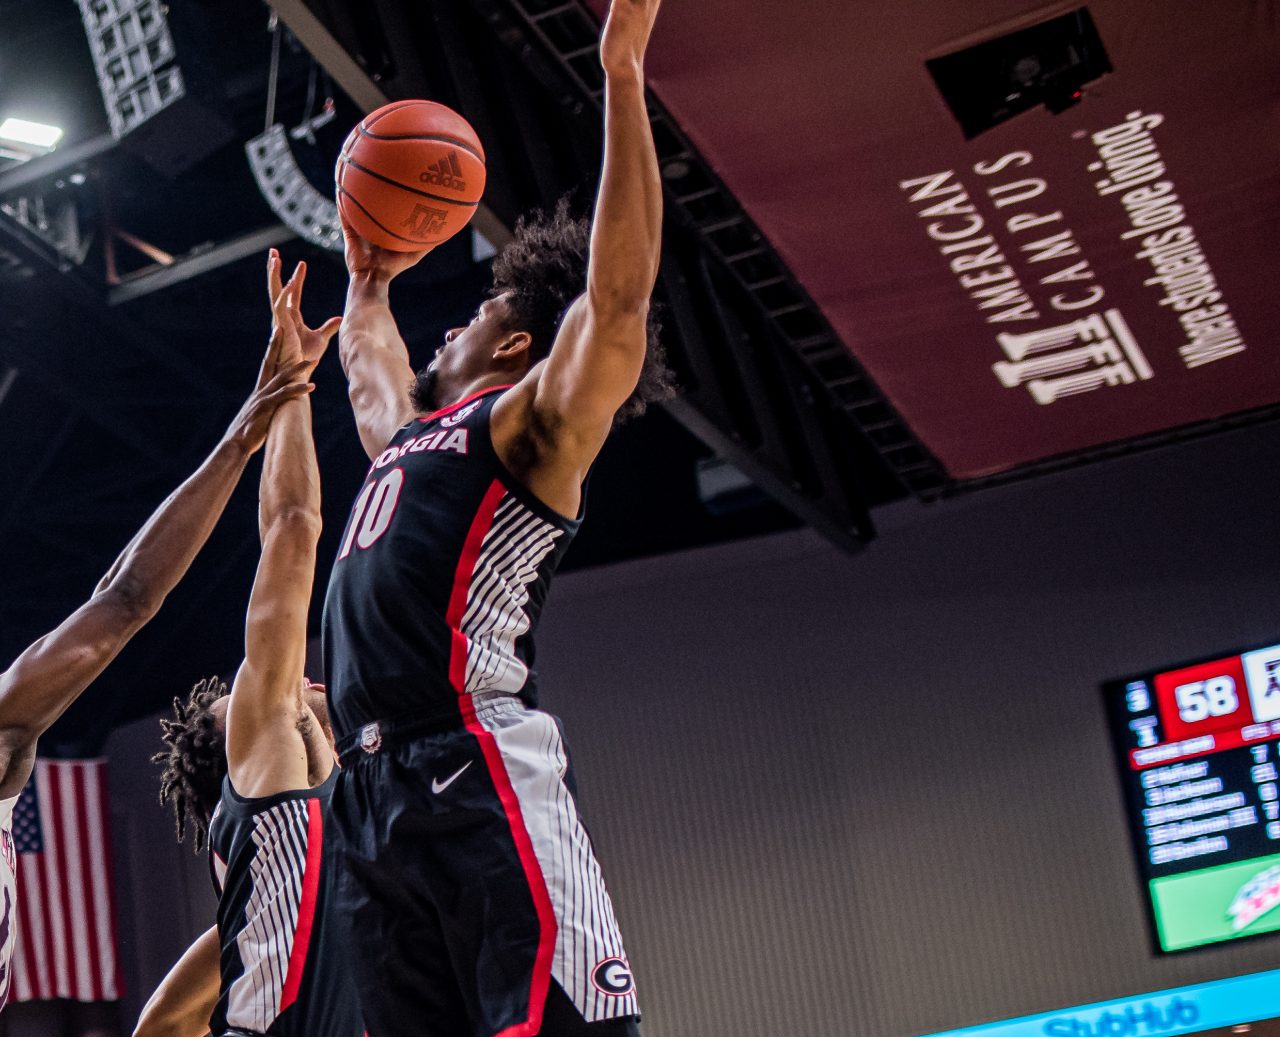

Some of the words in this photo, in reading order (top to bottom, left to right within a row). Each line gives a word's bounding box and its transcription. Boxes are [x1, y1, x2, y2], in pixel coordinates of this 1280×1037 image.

[420, 172, 465, 191] adidas
[1119, 180, 1184, 240] love
[899, 169, 1040, 324] AMERICAN
[973, 150, 1106, 311] CAMPUS
[1134, 224, 1223, 311] students
[1177, 301, 1247, 369] Where
[368, 428, 468, 475] ORGIA
[338, 466, 404, 560] 10
[1174, 675, 1239, 723] 58
[592, 958, 633, 995] G
